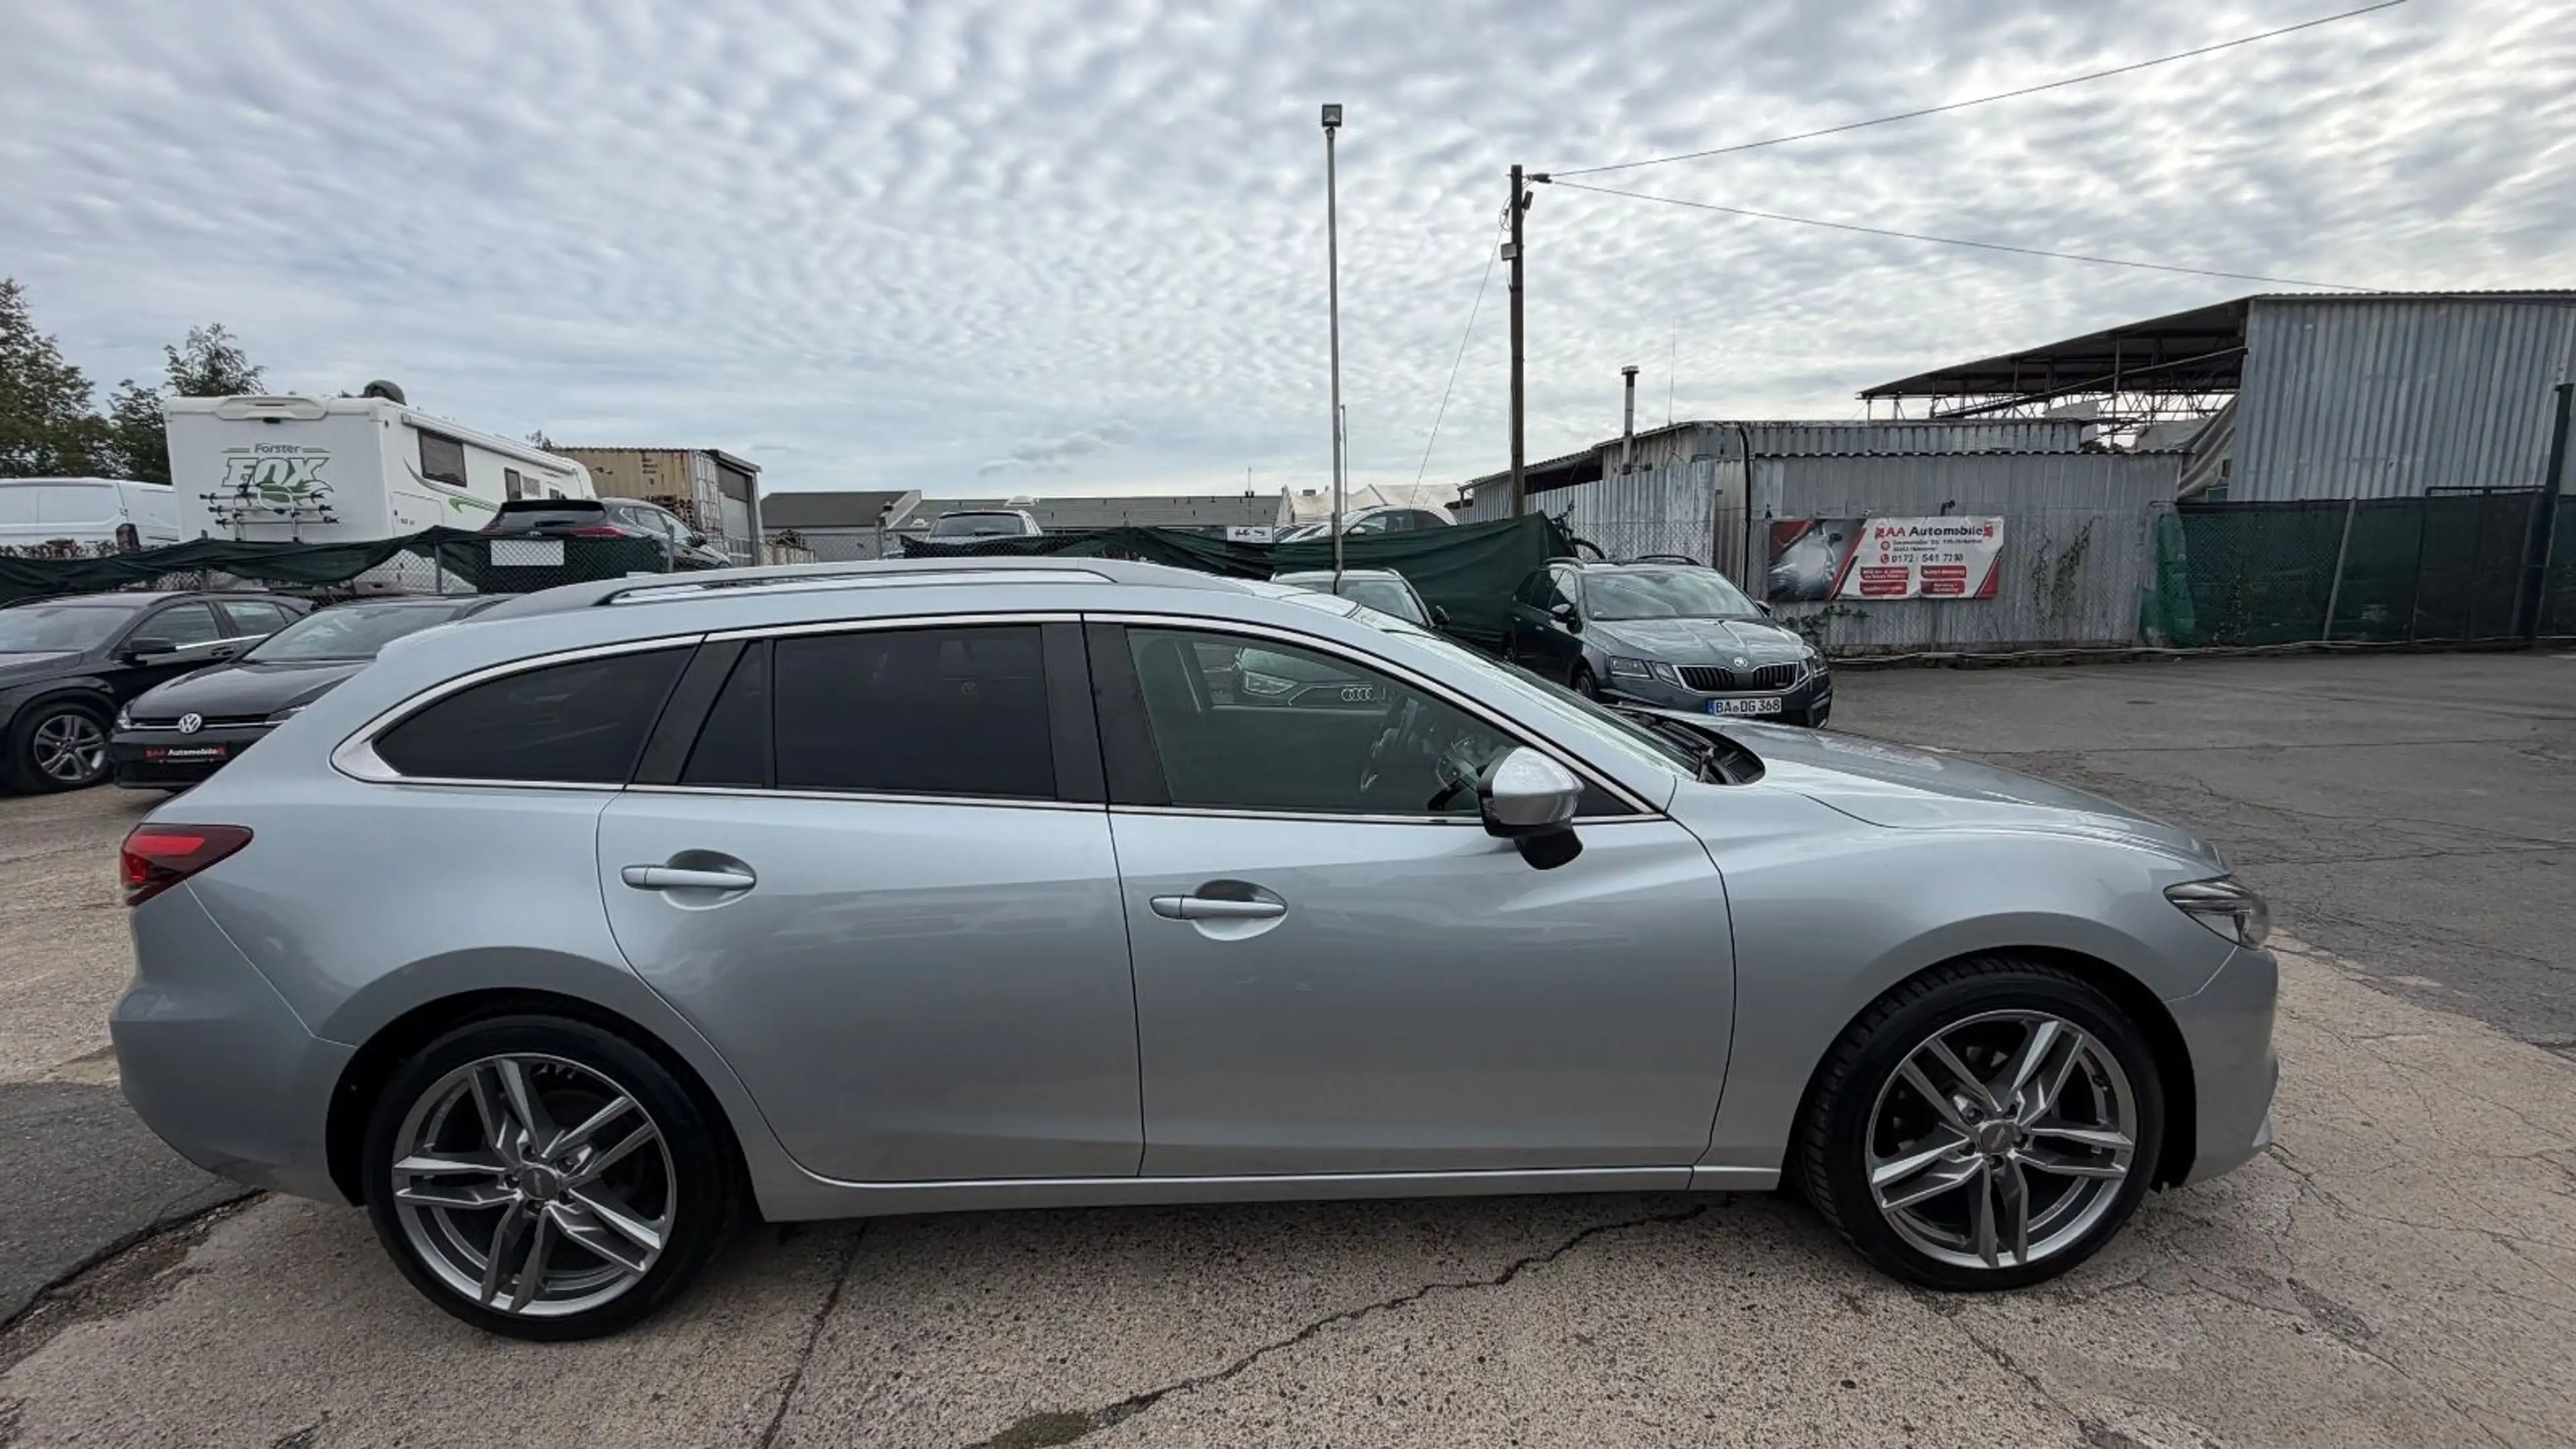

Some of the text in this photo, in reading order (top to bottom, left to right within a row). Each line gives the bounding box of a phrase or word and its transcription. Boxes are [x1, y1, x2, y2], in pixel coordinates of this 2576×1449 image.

[255, 443, 300, 453] Forster
[221, 457, 330, 488] FOX
[1716, 699, 1780, 712] BA DG 368
